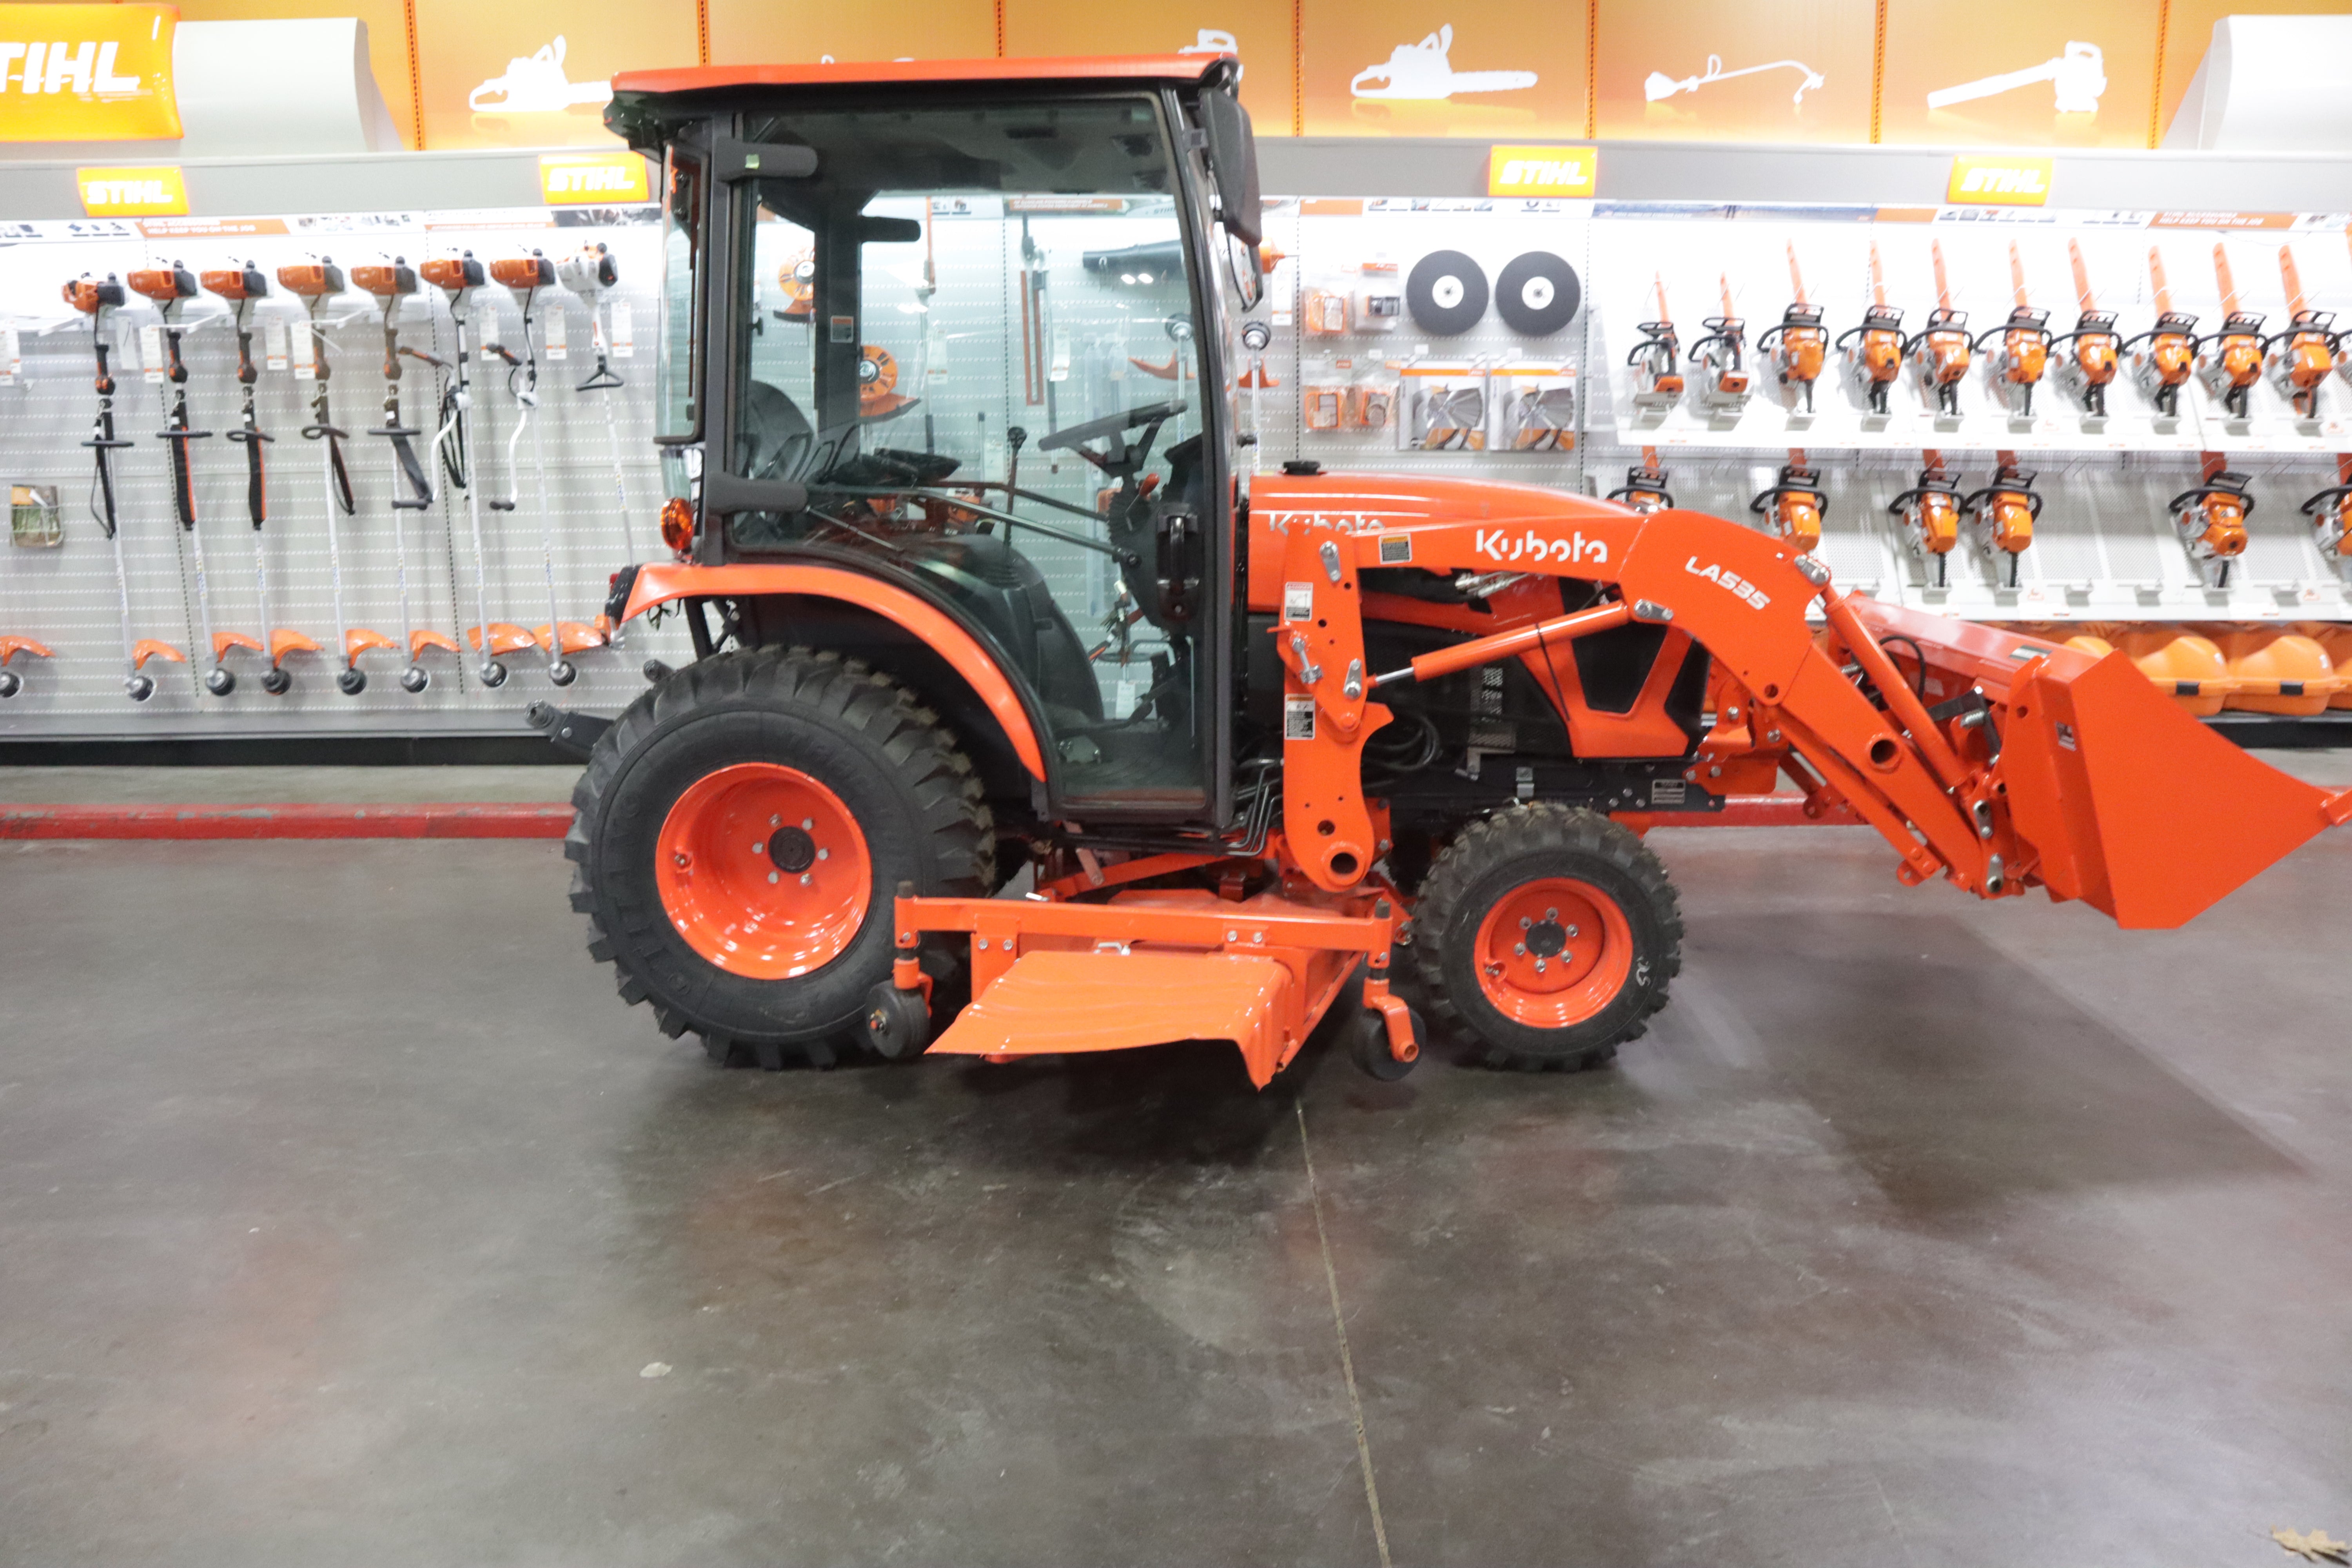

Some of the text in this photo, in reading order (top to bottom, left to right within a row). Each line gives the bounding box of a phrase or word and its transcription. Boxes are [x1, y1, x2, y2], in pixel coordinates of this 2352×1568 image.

[548, 166, 635, 191] STIHL
[1499, 160, 1588, 185] STIHL
[1960, 167, 2045, 193] STIHL
[87, 180, 172, 204] STIHL
[1476, 529, 1608, 563] Kubota
[1685, 556, 1771, 610] LA535
